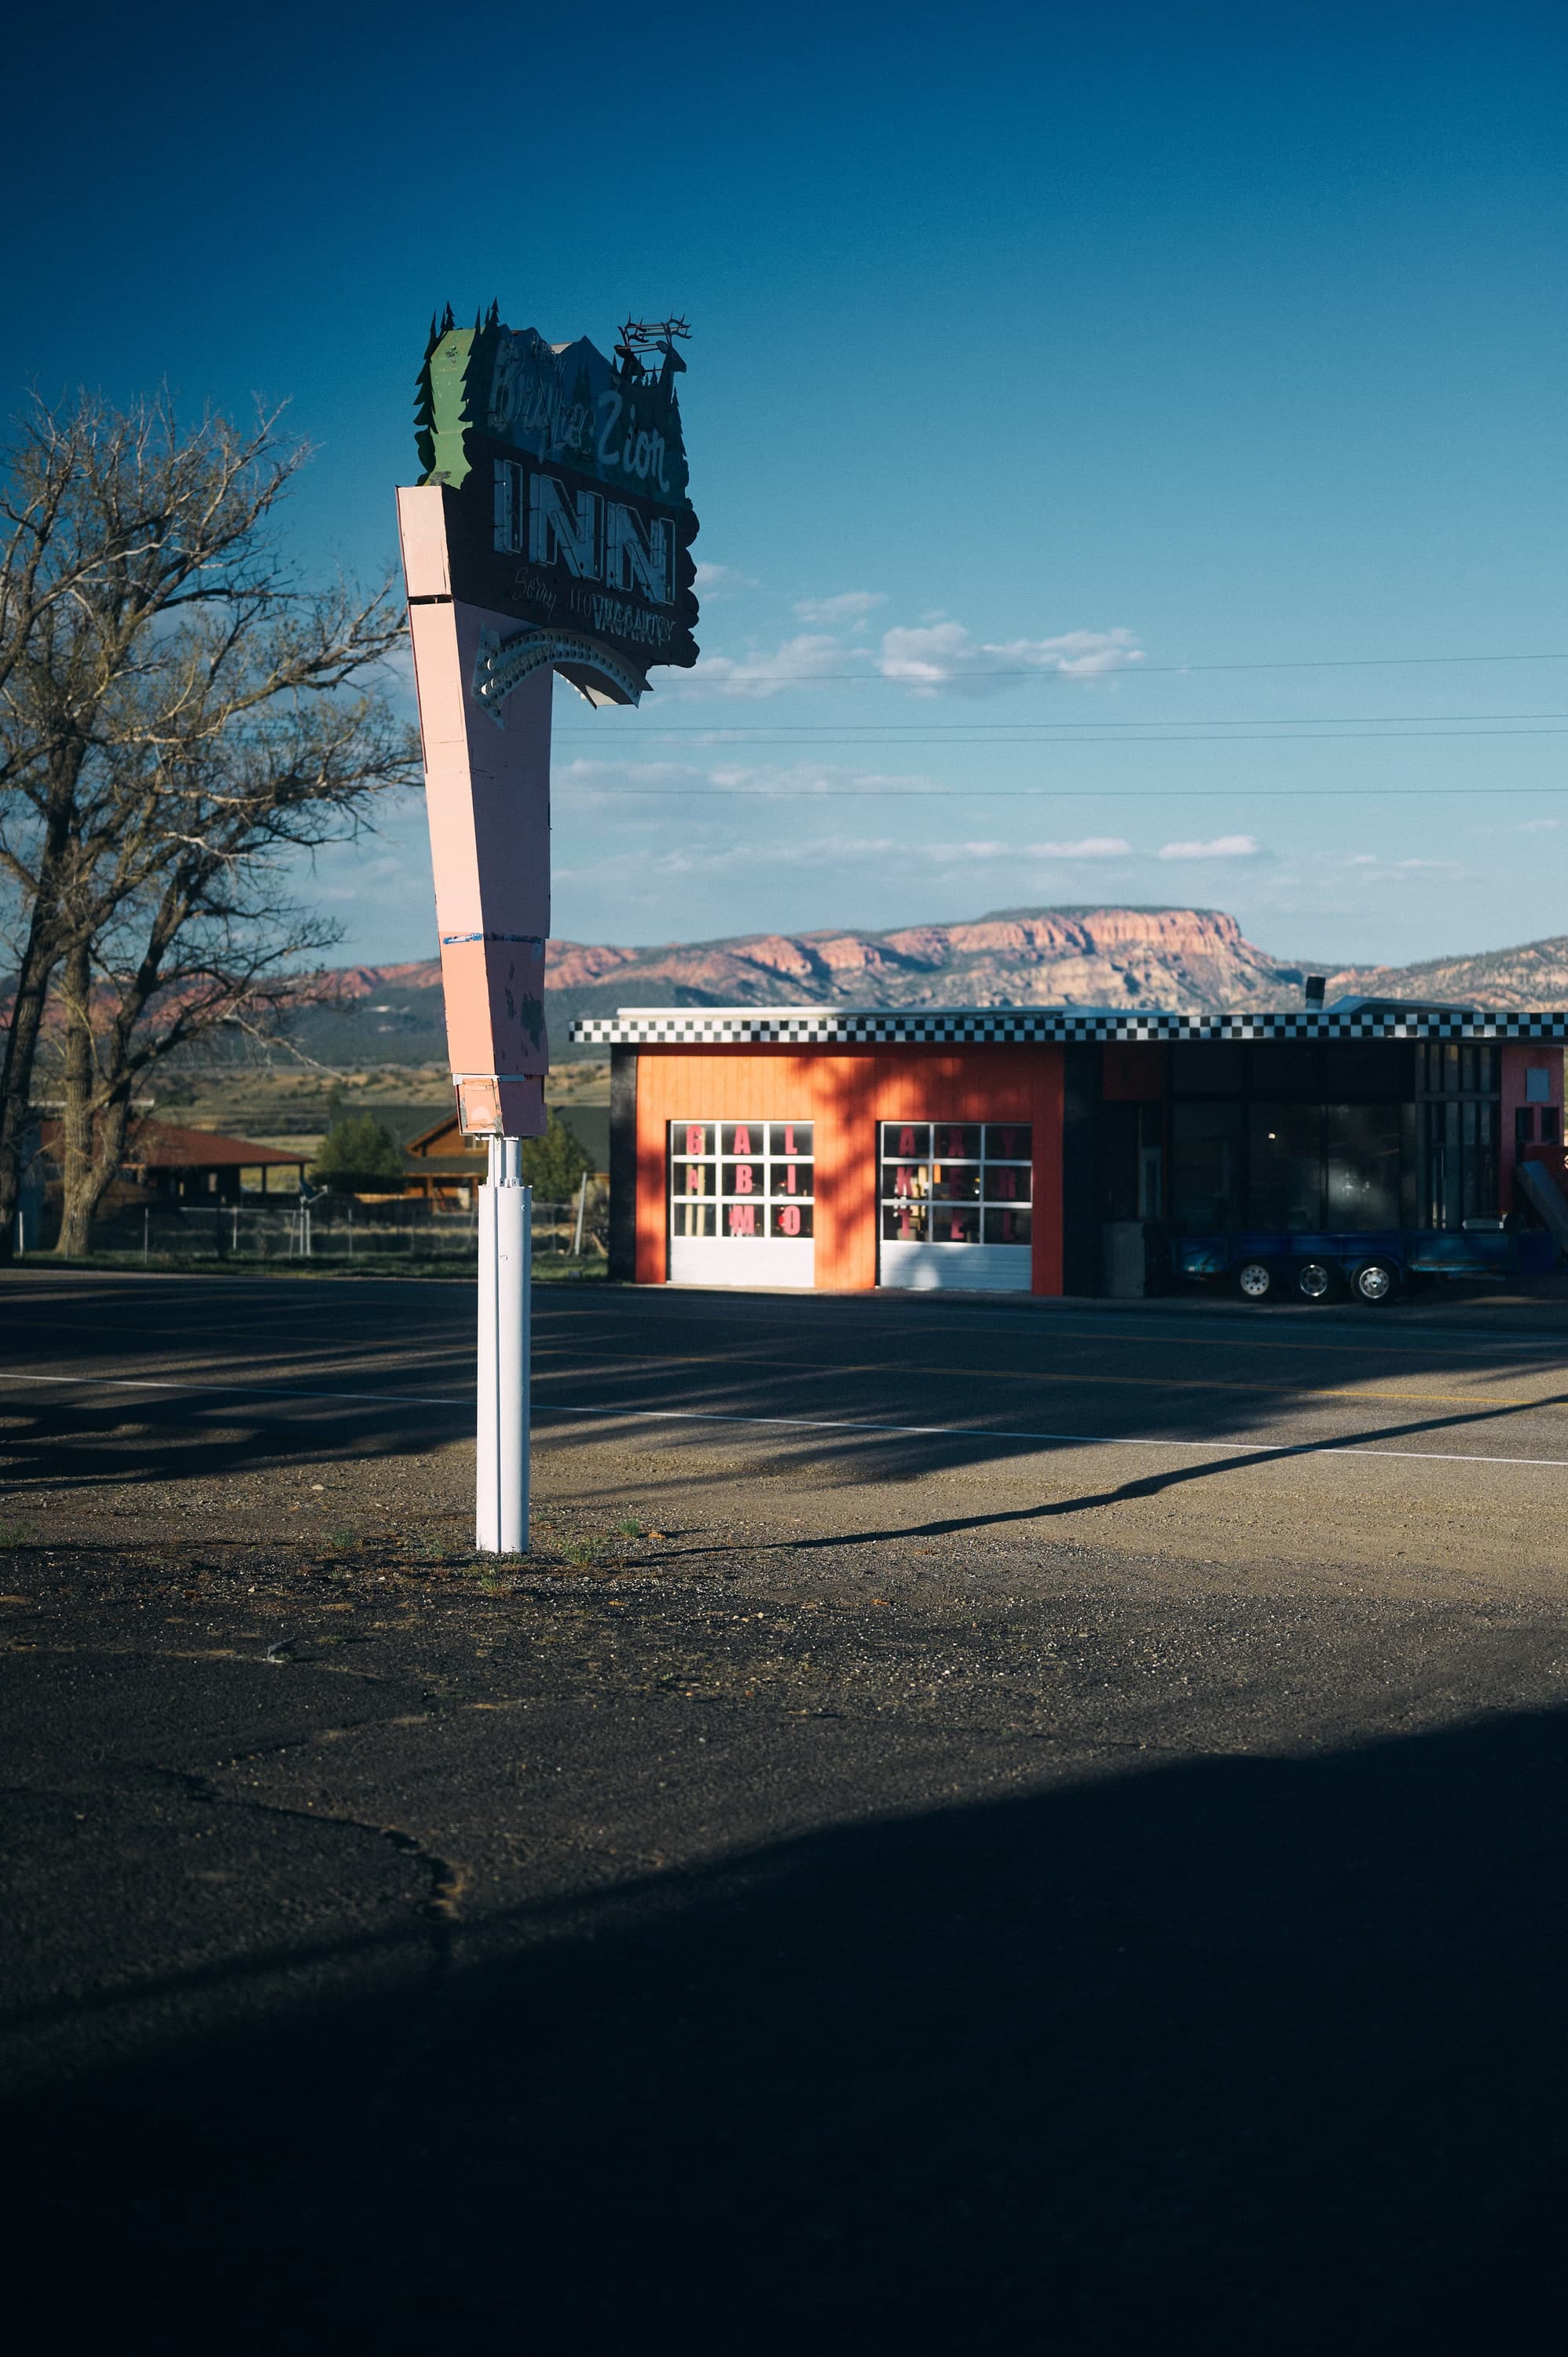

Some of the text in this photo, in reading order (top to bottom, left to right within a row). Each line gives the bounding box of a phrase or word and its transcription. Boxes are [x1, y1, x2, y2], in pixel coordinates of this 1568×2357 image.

[598, 390, 670, 493] Zion
[493, 457, 676, 606] INN
[511, 564, 557, 621] Sorry
[592, 593, 676, 647] VACANCY
